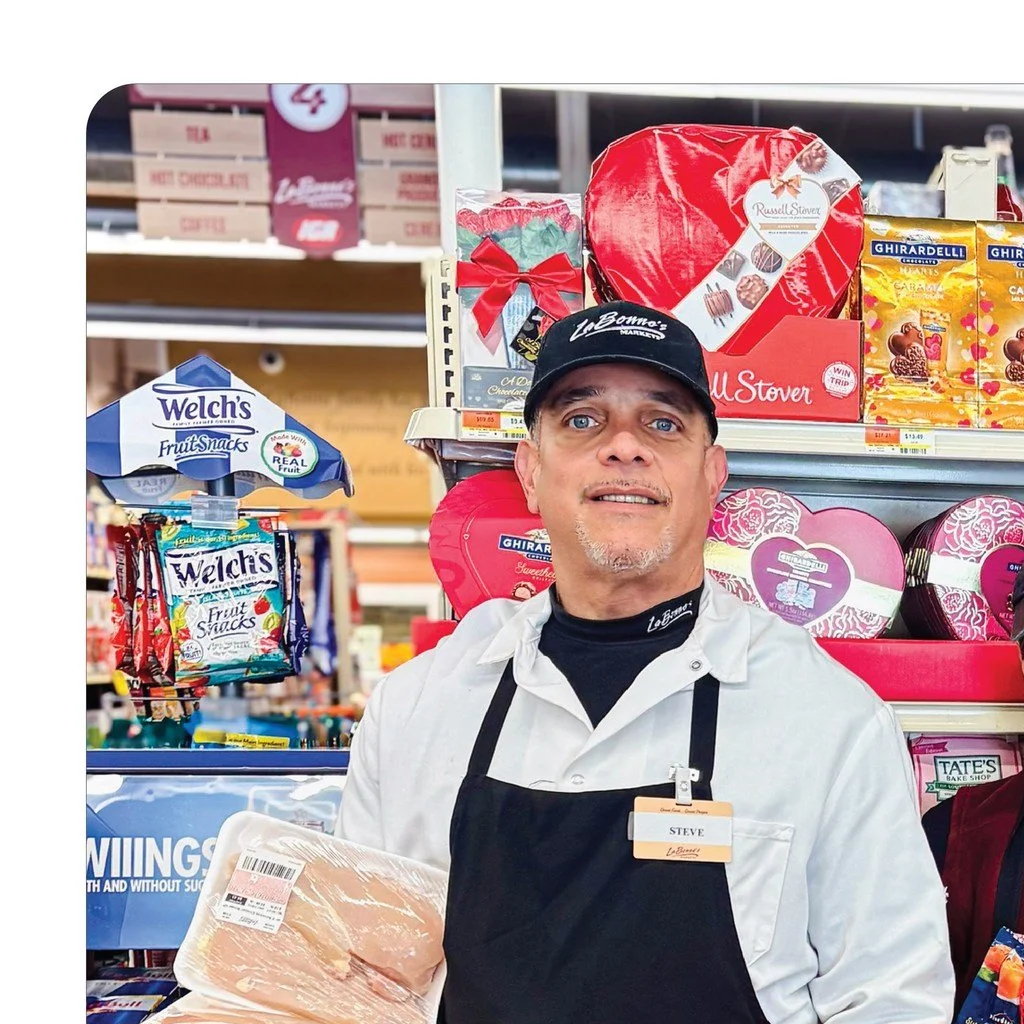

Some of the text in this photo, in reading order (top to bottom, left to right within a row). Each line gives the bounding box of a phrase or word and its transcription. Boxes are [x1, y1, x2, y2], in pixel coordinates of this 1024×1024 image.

[290, 84, 326, 115] 4
[752, 202, 820, 219] Russell Stover
[180, 217, 226, 234] COFFEE
[874, 243, 964, 260] GHIRARDELLI
[833, 367, 851, 377] WIN
[735, 370, 812, 405] Stover
[830, 377, 849, 387] TRIP
[157, 395, 251, 421] Welch's
[158, 434, 249, 458] Fruit Snacks
[271, 434, 290, 443] Made
[272, 457, 307, 467] REAL
[278, 465, 300, 474] Fruit
[169, 550, 273, 588] Welch's
[208, 602, 248, 623] Fruit
[197, 616, 256, 639] Snacks
[939, 759, 997, 775] TATE'S
[670, 826, 704, 837] STEVE
[103, 879, 181, 893] AND WITHOUT
